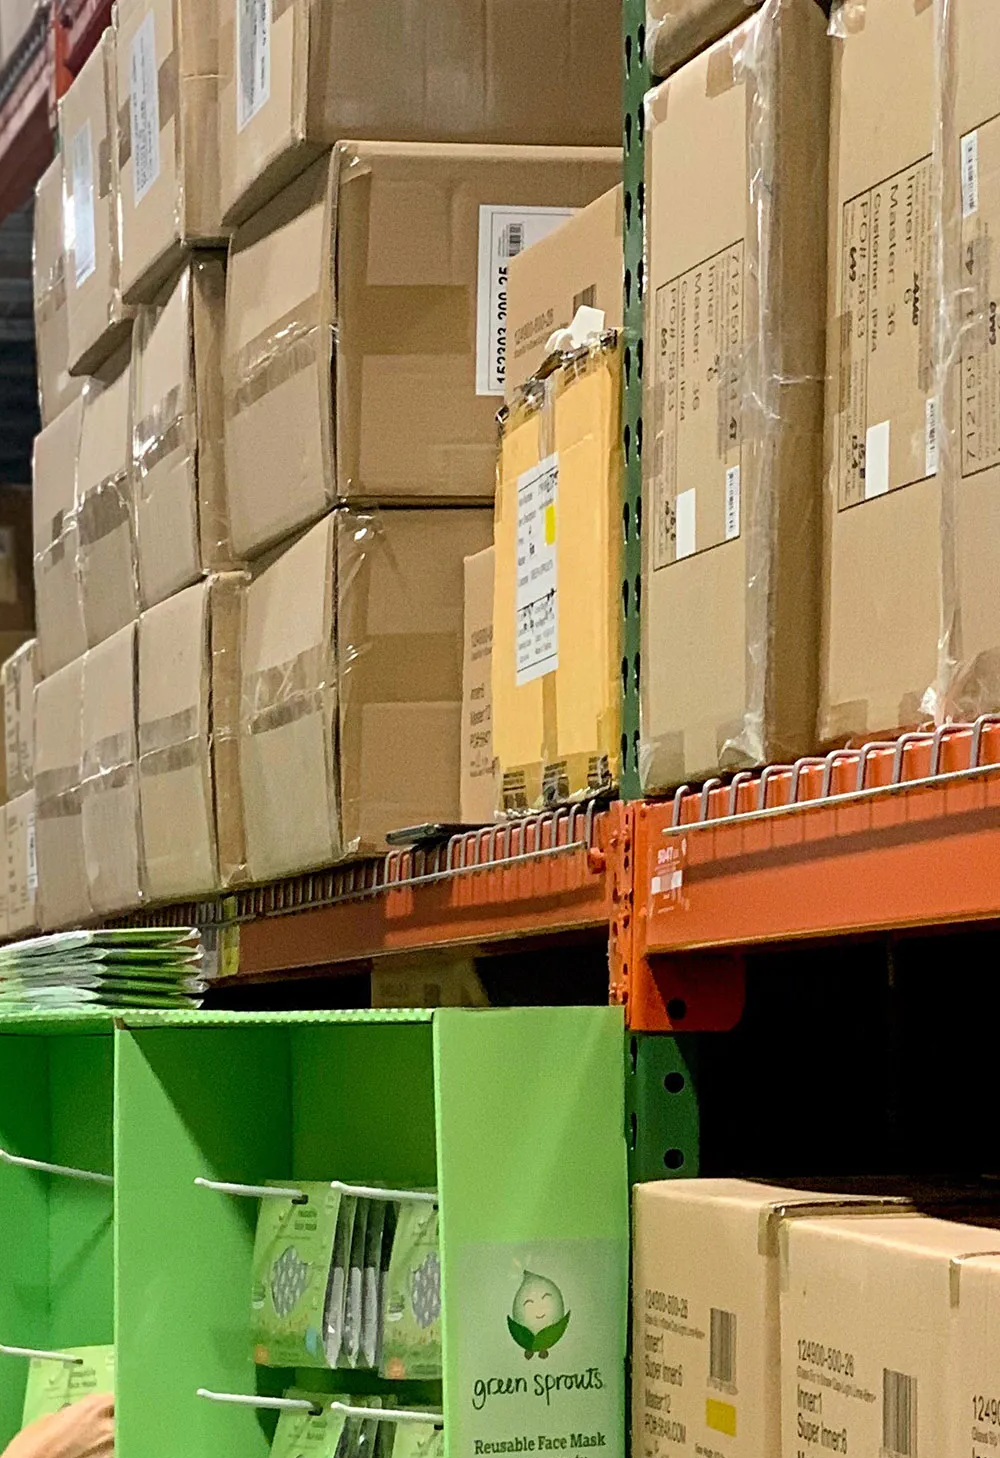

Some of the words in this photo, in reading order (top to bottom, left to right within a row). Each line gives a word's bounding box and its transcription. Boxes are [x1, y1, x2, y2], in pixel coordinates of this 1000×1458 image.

[472, 1377, 528, 1410] green
[533, 1367, 604, 1406] sprouts
[474, 1436, 536, 1455] Reusable
[537, 1435, 568, 1451] Face
[570, 1431, 607, 1449] Mask
[797, 1412, 820, 1447] Super
